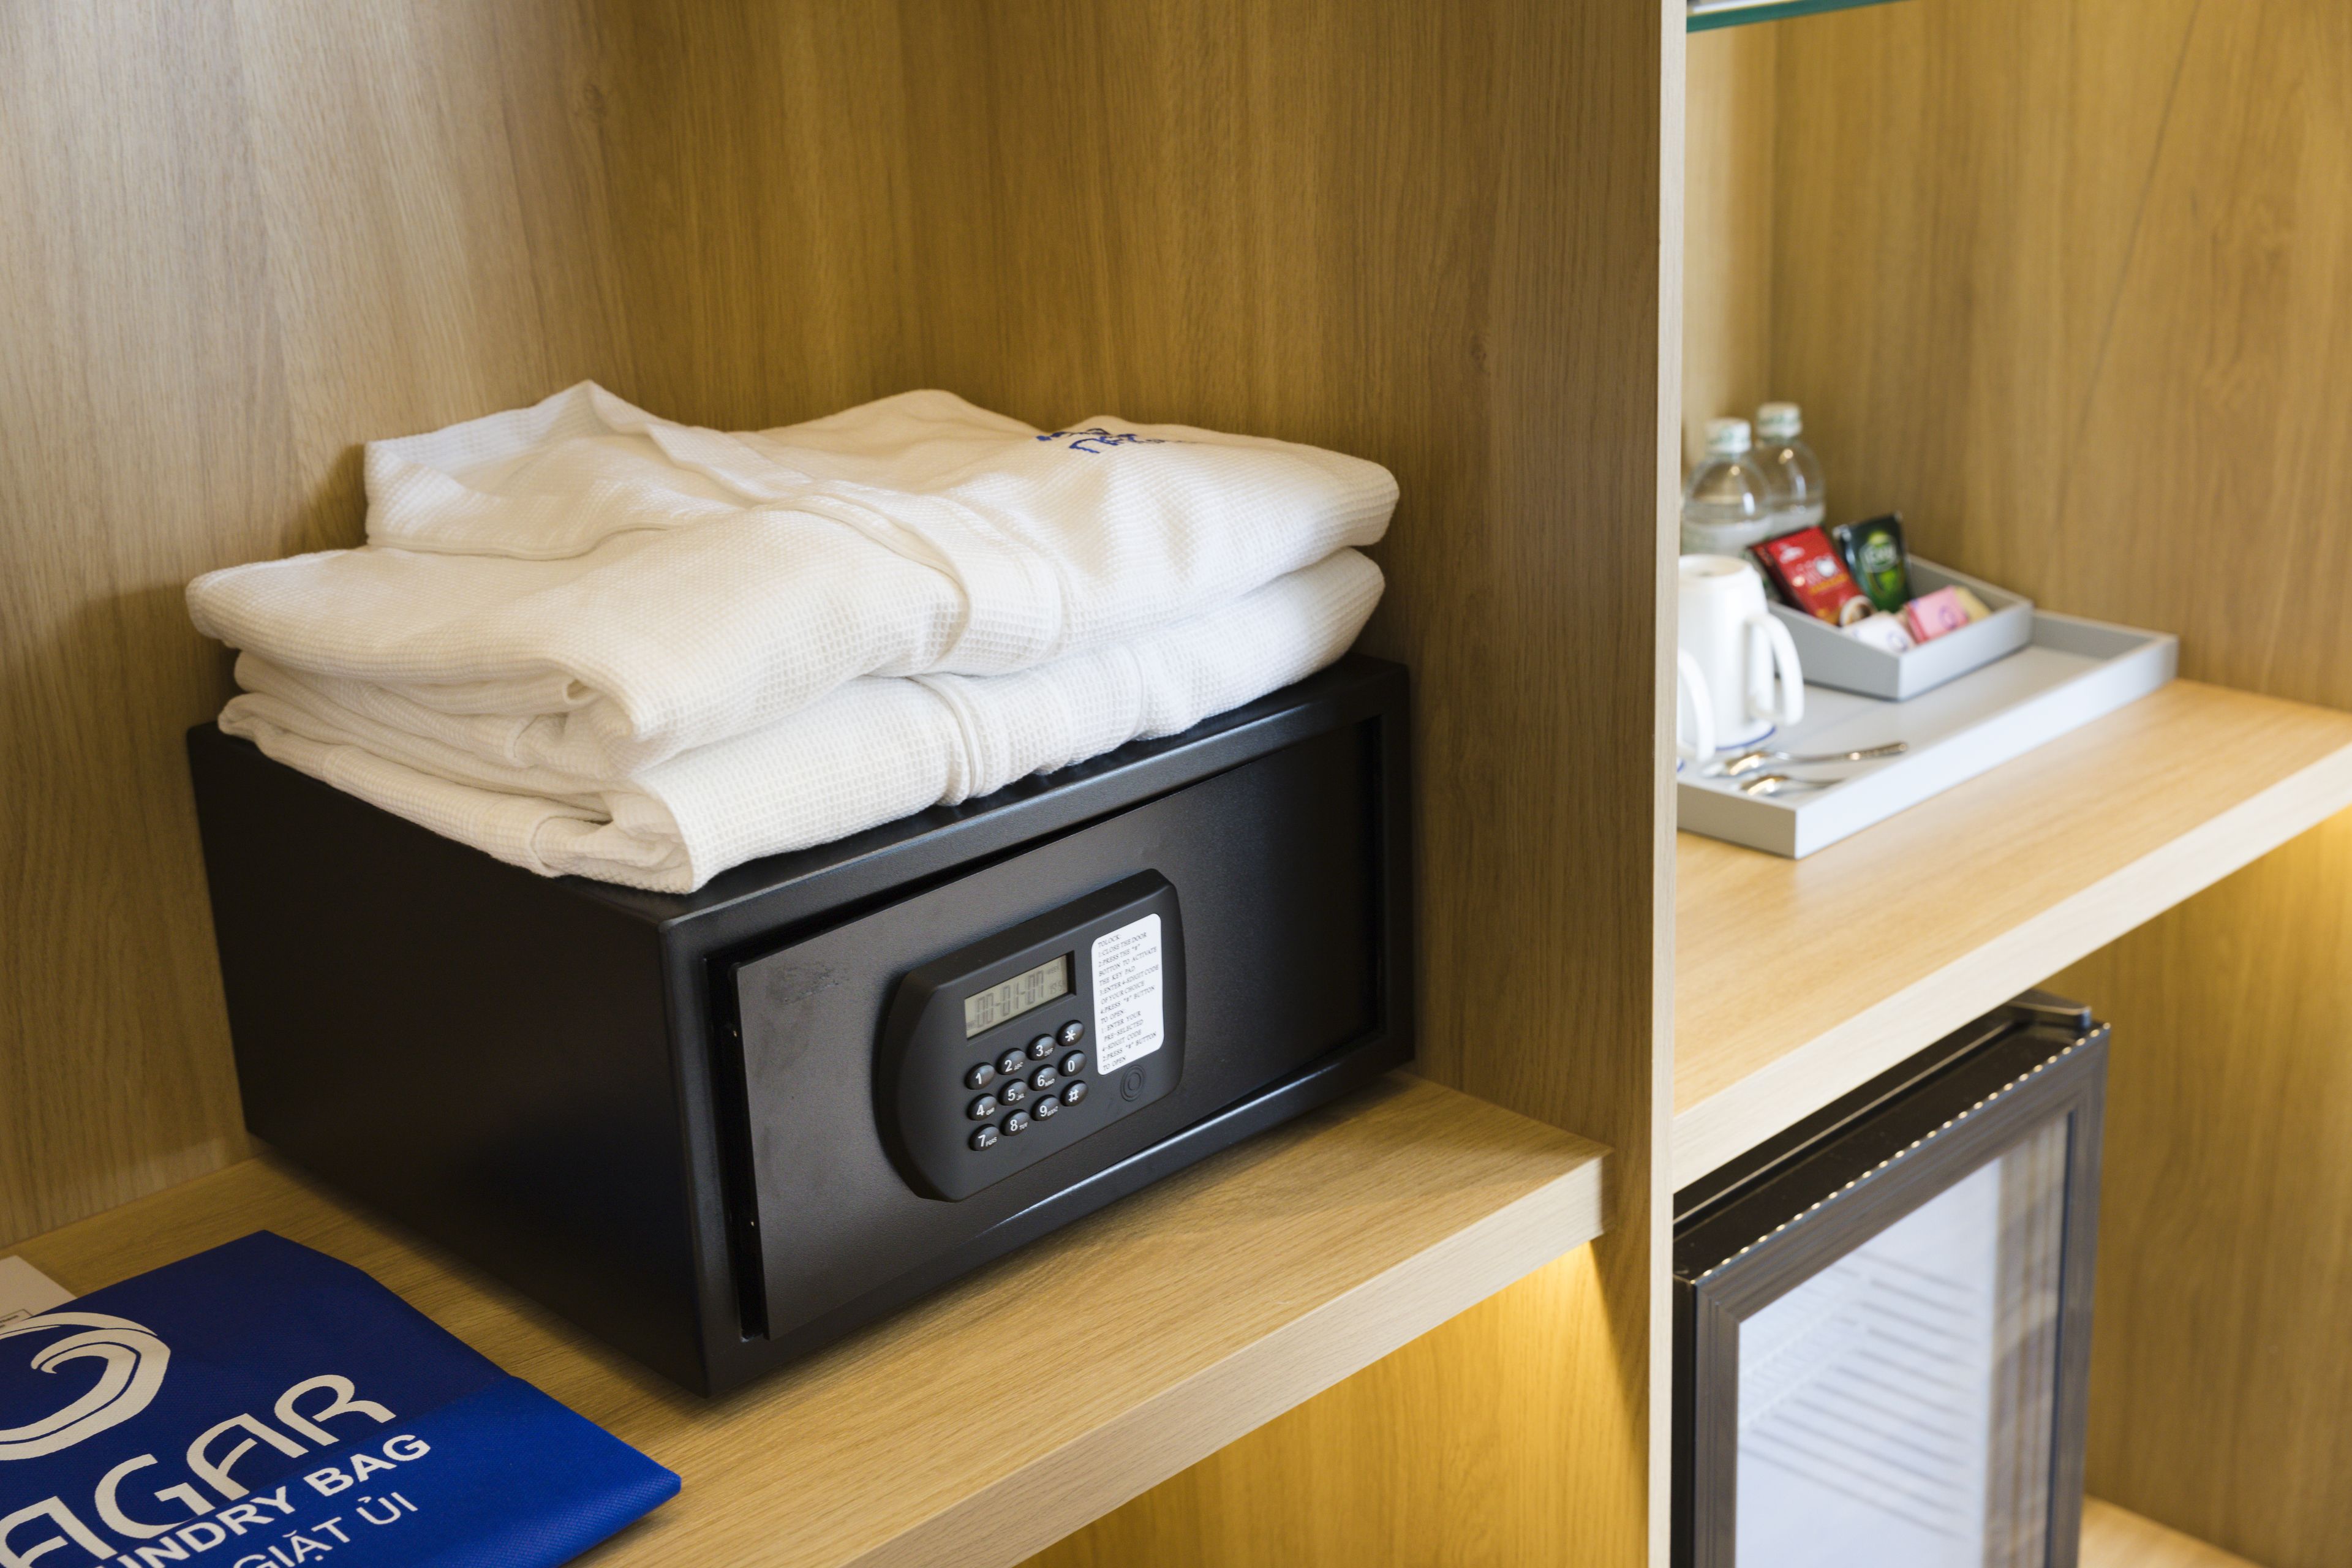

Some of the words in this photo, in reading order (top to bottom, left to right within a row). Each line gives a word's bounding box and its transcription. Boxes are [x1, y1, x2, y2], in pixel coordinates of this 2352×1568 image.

[1036, 1045, 1044, 1057] 3
[1005, 1060, 1012, 1072] 2
[1068, 1060, 1075, 1072] 0
[976, 1073, 982, 1084] 1
[1038, 1075, 1045, 1087] 6
[1008, 1089, 1016, 1101] 5
[976, 1104, 985, 1115] 4
[1039, 1106, 1047, 1117] 9
[1010, 1120, 1018, 1131] 8
[978, 1134, 986, 1147] 7
[303, 1434, 431, 1496] BAG
[356, 1492, 418, 1525] ỦI
